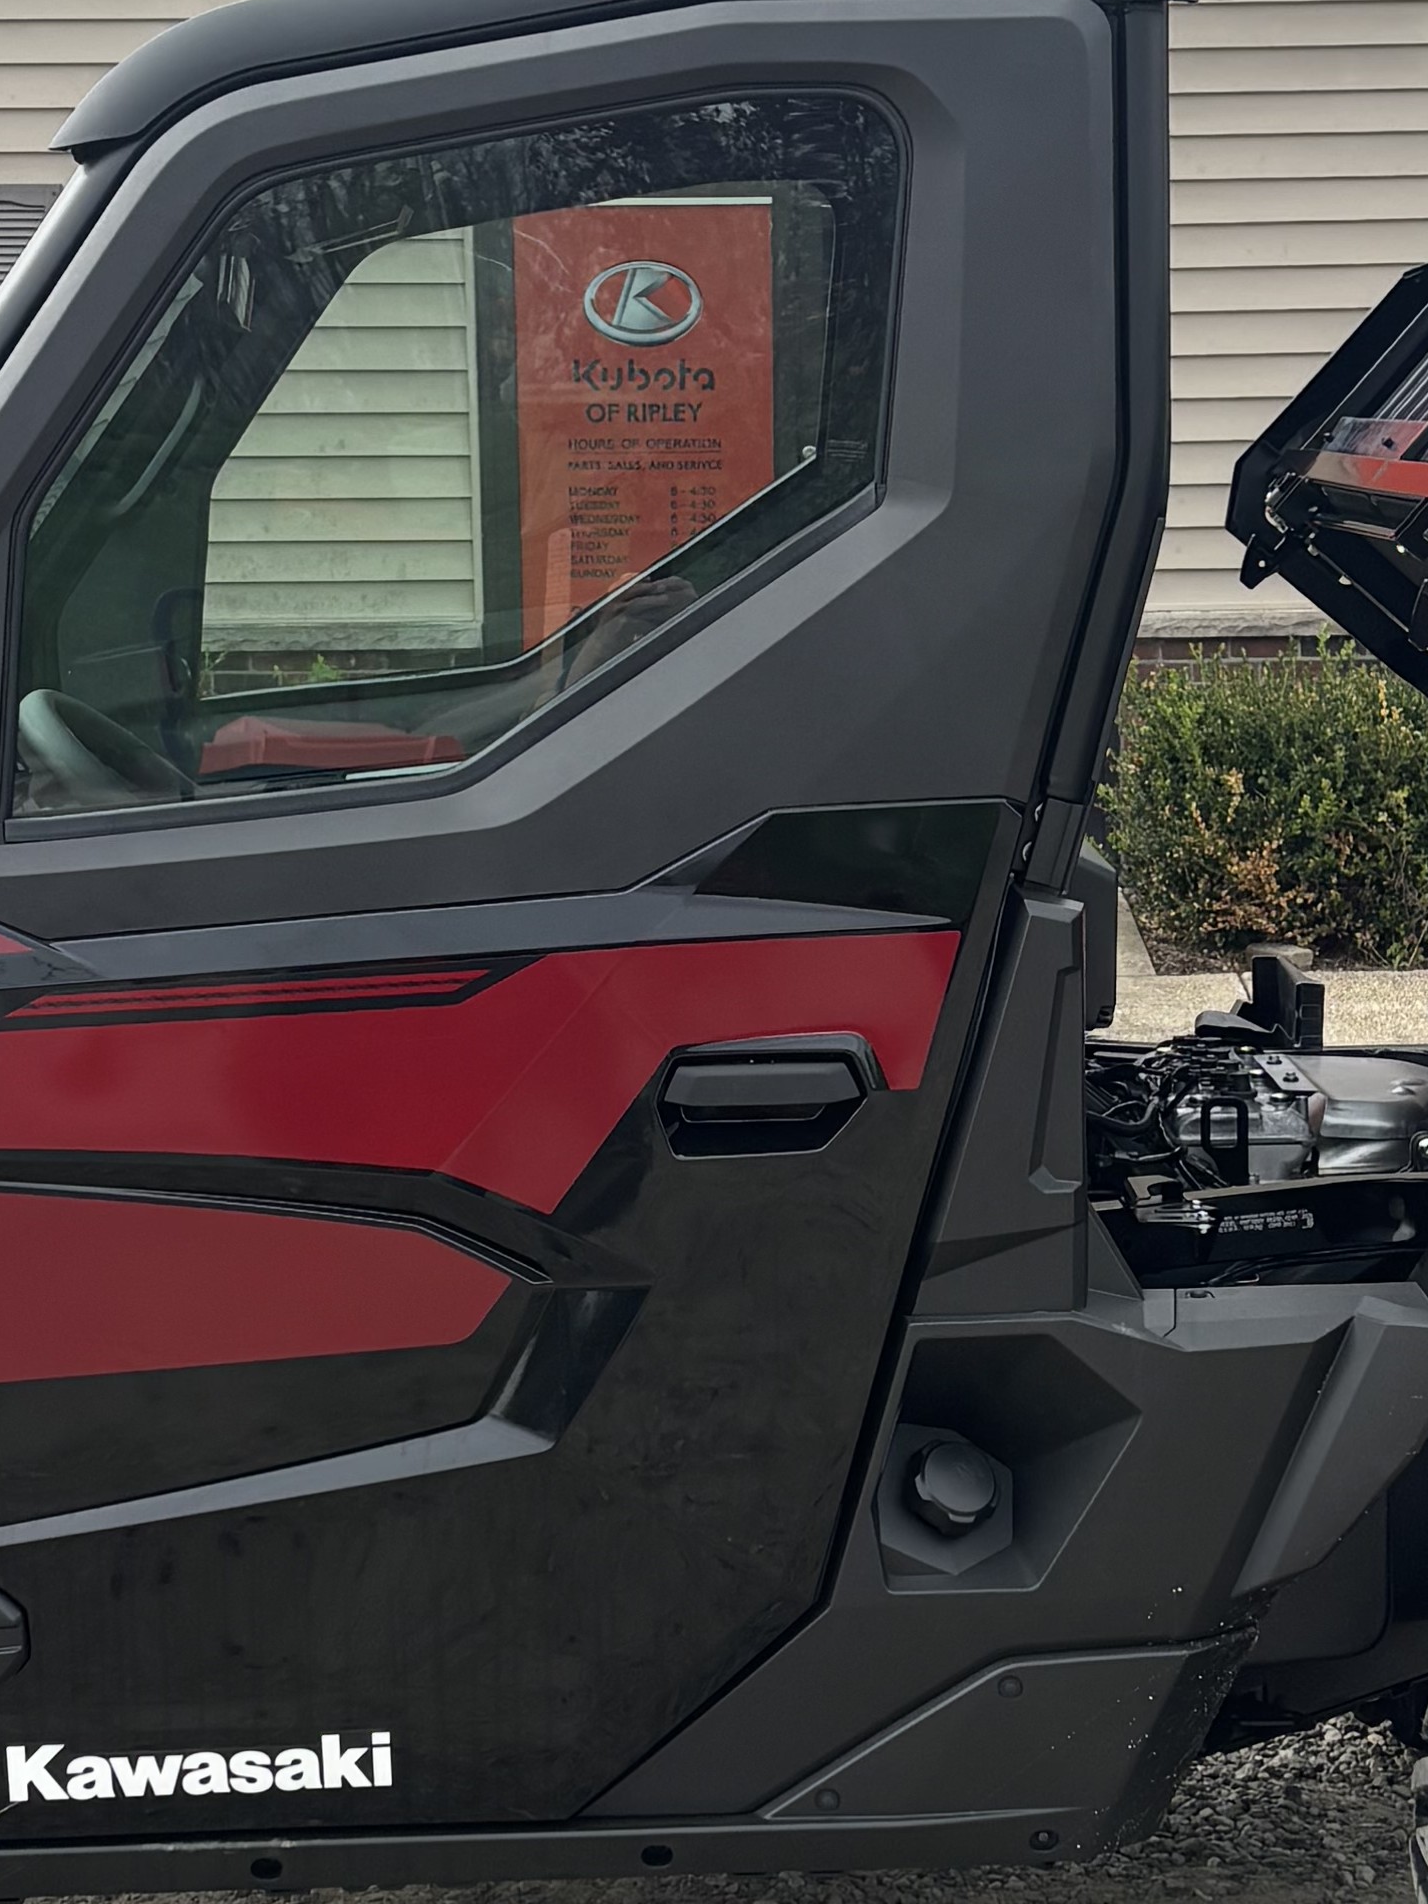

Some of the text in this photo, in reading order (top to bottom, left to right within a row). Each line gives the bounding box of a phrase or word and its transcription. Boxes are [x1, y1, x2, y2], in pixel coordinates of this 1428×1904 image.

[573, 358, 716, 391] Kubota
[585, 402, 703, 423] OF RIPLEY
[646, 438, 721, 449] OPERATION
[6, 1731, 393, 1802] Kawasaki
